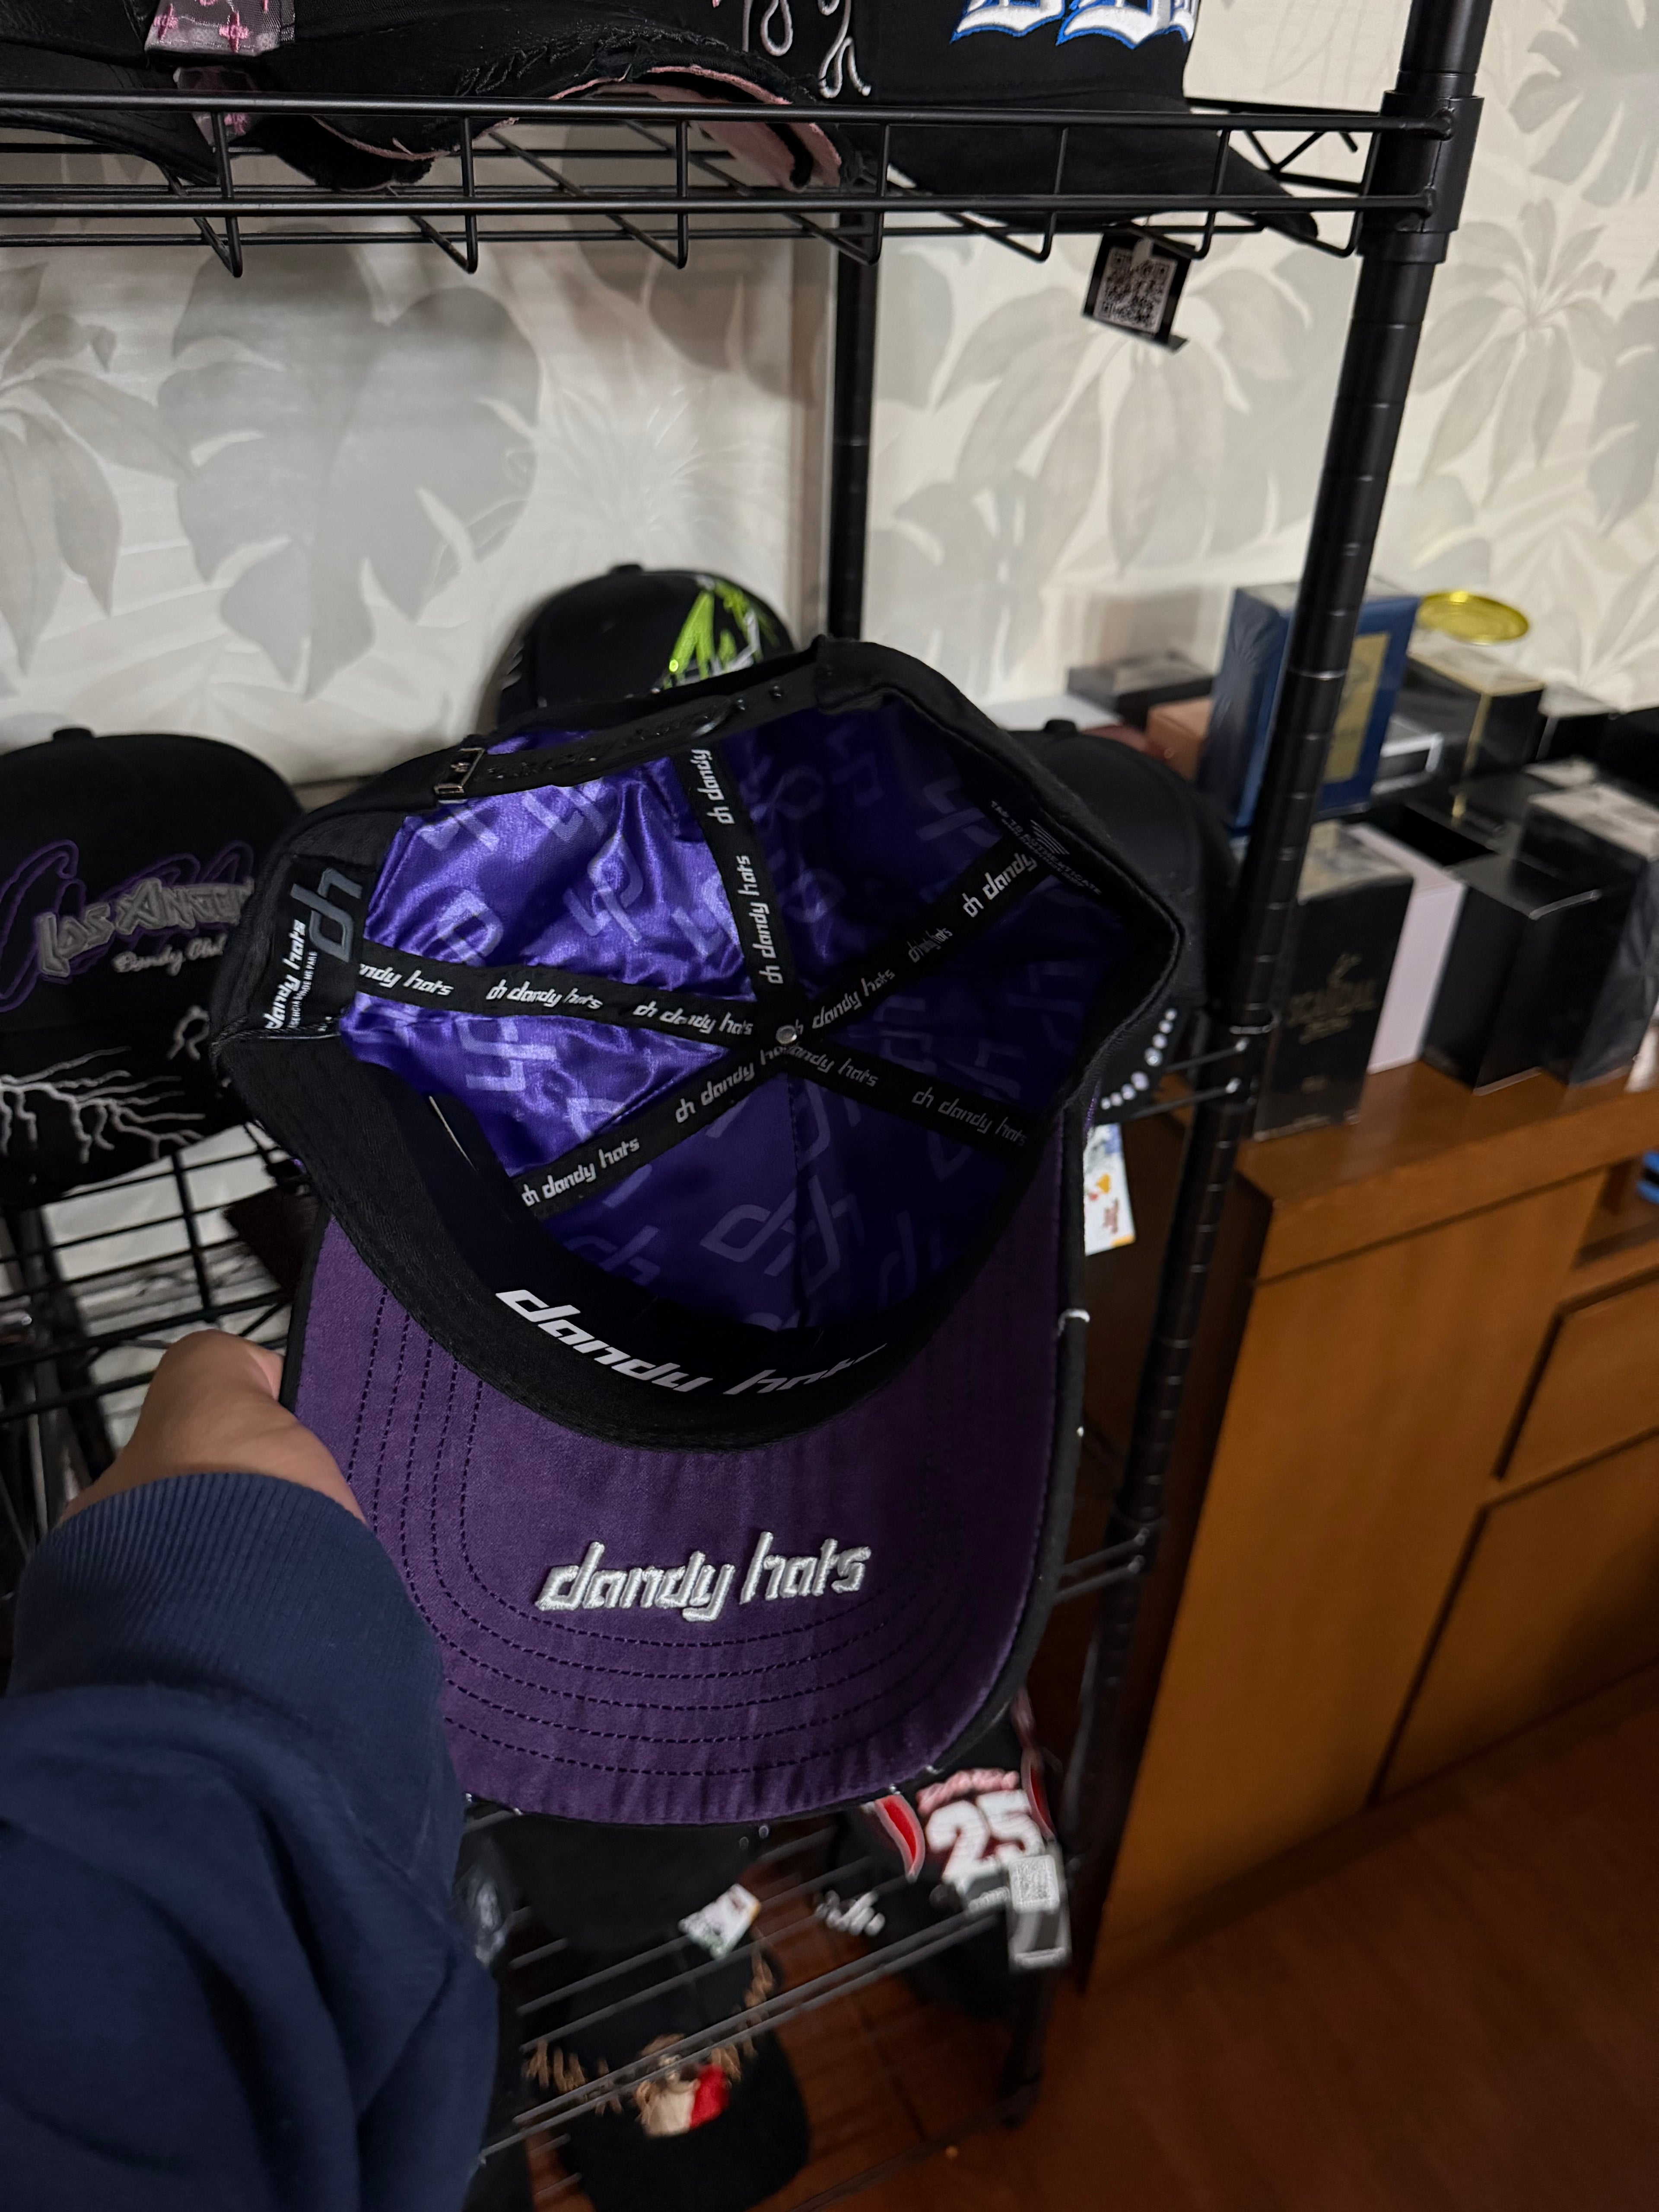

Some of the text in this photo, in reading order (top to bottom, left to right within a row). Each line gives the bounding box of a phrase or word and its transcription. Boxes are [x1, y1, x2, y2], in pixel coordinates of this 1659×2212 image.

[690, 749, 725, 801] dandy
[736, 855, 760, 896] hats
[982, 852, 1037, 900] dandy
[749, 902, 776, 959] dandy
[263, 919, 306, 1030] dandy hats
[404, 969, 454, 996] hats
[507, 981, 562, 1008] dandy
[563, 988, 603, 1010] hats
[811, 987, 862, 1029] dandy
[863, 967, 896, 997] hats
[700, 1062, 755, 1106] dandy
[838, 1058, 879, 1087] hats
[938, 1098, 993, 1134] dandy
[995, 1116, 1029, 1148] hats
[541, 1162, 597, 1198] dandy
[598, 1136, 640, 1168] hats
[535, 1532, 871, 1621] dandy hats
[925, 1789, 1046, 1883] 25
